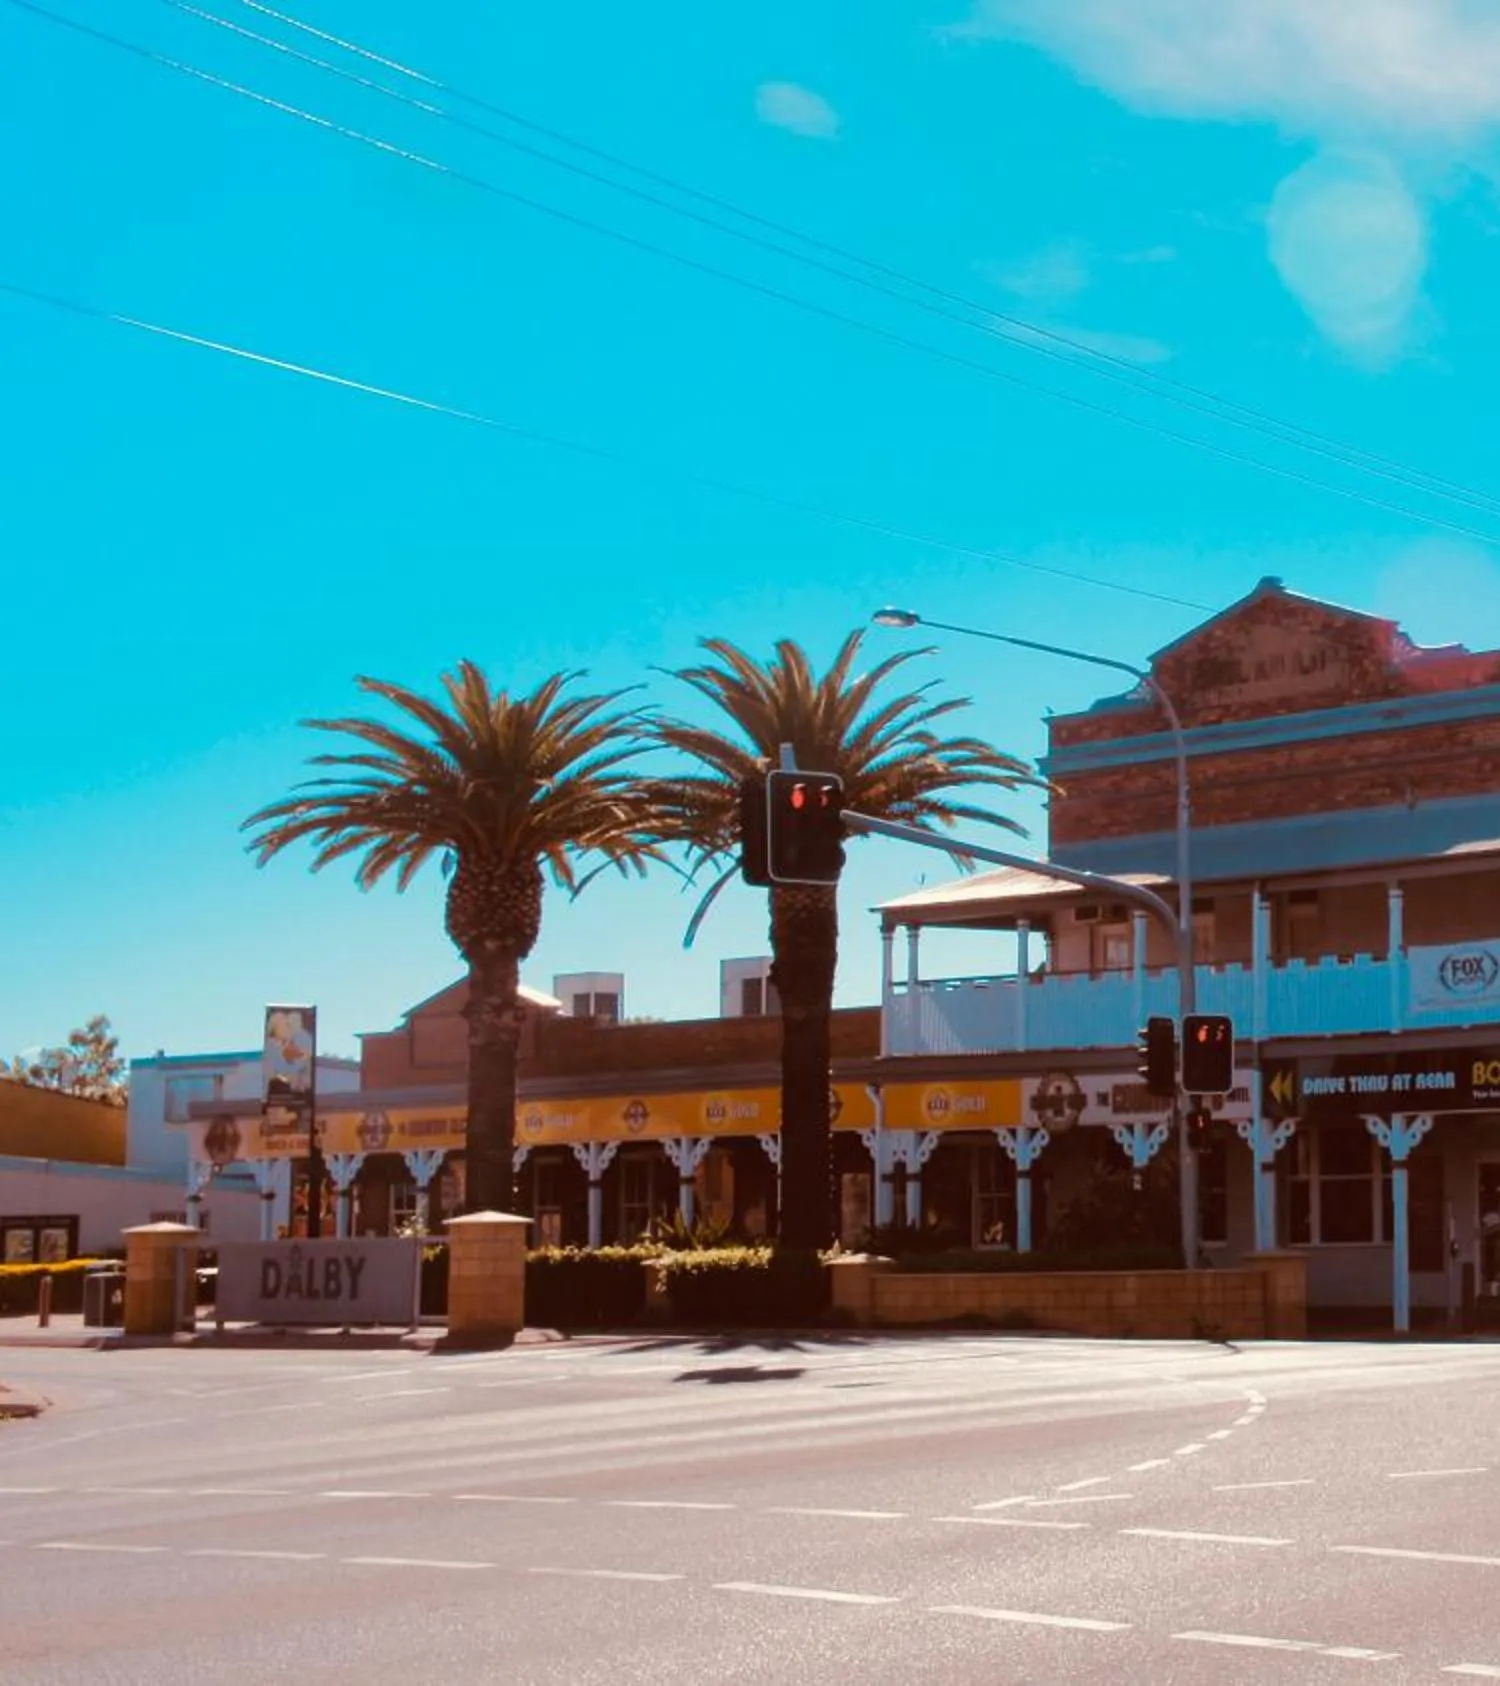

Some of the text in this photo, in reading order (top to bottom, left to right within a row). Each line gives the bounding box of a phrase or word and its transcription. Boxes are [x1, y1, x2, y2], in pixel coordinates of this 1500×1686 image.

[1450, 956, 1485, 977] FOX
[1302, 1077, 1346, 1096] DRIVE
[1348, 1074, 1389, 1094] THRU
[1391, 1074, 1412, 1092] AT
[260, 1246, 367, 1301] DALBY
